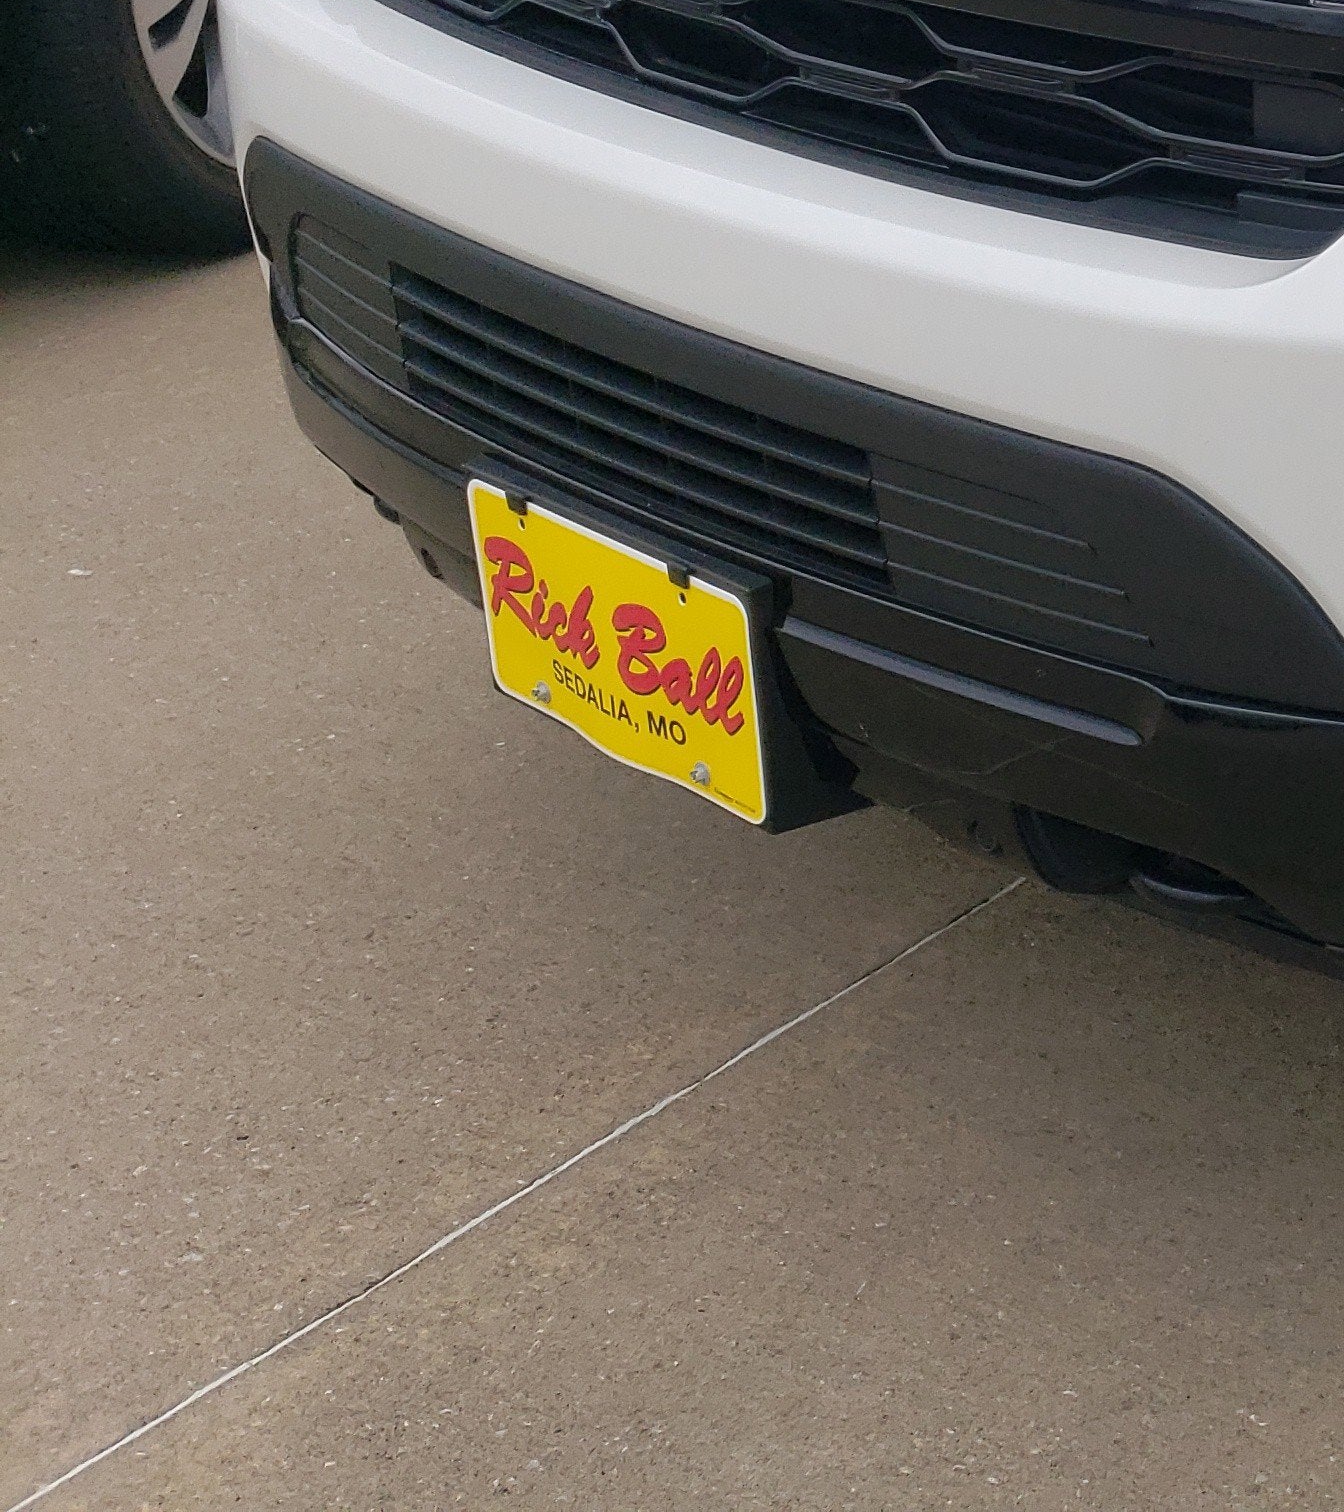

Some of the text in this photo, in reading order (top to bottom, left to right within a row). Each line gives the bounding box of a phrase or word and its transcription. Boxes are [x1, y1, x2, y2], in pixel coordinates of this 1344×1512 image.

[483, 535, 745, 736] Rick Ball
[552, 658, 687, 746] SEDALIA, MO
